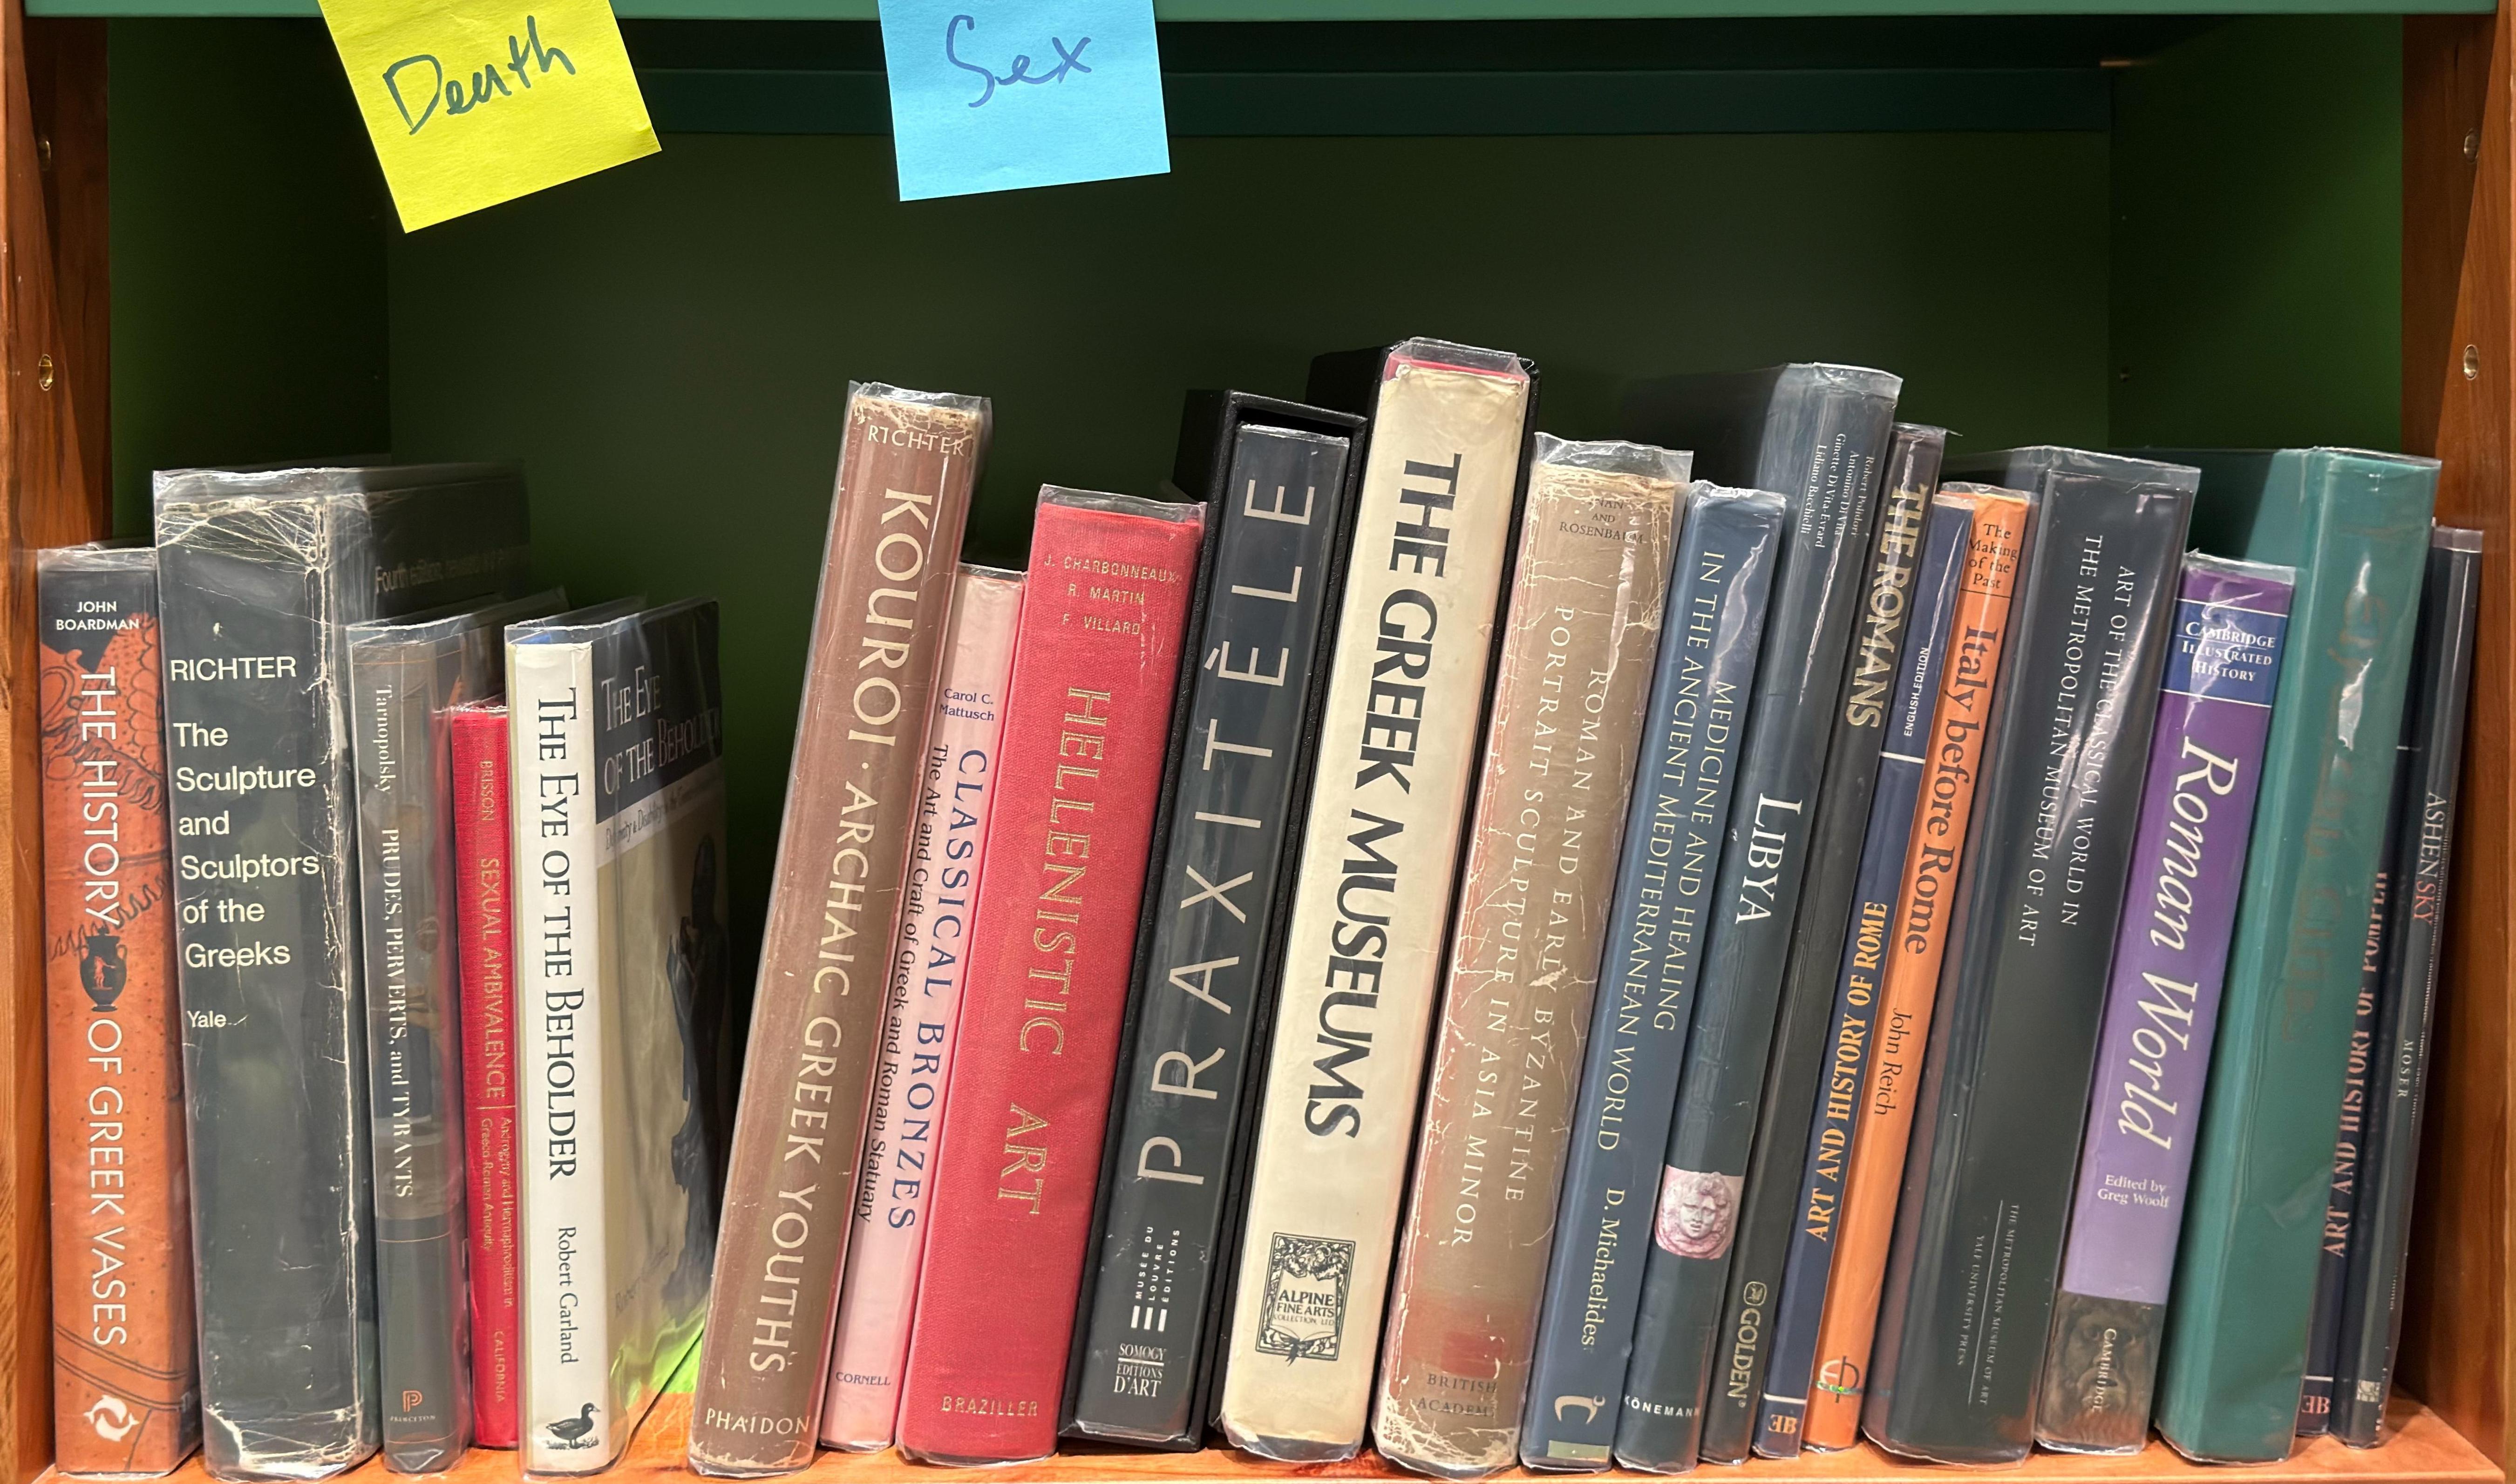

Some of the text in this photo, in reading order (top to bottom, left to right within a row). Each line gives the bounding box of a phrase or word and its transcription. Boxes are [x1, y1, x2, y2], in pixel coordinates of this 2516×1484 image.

[382, 15, 576, 135] Death
[946, 14, 1092, 108] Sex
[868, 425, 965, 457] RICHTER
[1830, 434, 1846, 471] Ginette
[1801, 445, 1827, 534] Lidiano Bacchielli
[1843, 451, 1859, 498] Antonino
[1592, 513, 1615, 523] AND
[1969, 539, 2018, 560] Making
[1984, 523, 2011, 539] The
[1090, 586, 1144, 604] MARTIN
[1969, 557, 2011, 574] of the
[1972, 573, 2001, 589] Past
[56, 618, 139, 631] BOARDMAN
[77, 601, 117, 613] JOHN
[1083, 616, 1141, 635] VILLARD
[1846, 482, 1929, 729] THE ROMANS
[170, 656, 296, 682] RICHTER
[944, 688, 993, 705] Carol C.
[1904, 646, 1929, 737] ENGLISH EDITION
[2195, 661, 2257, 682] HISTORY
[173, 723, 229, 747] The
[373, 684, 396, 794] Tarnopolsky
[940, 704, 994, 721] Mattusch
[2019, 535, 2102, 947] THE METROPOLITAN MUSEUM OF ART
[626, 737, 655, 784] THE
[2061, 566, 2136, 926] ART OF THE CLASSICAL WORLD IN
[176, 765, 316, 795] Sculpture
[478, 761, 494, 821] BRISSON
[1304, 454, 1462, 1138] THE GREEK MUSEUMS
[1904, 625, 1999, 955] Italy before Rome
[179, 811, 230, 835] and
[1137, 479, 1315, 1185] PRAXITÈLE
[1598, 551, 1725, 1151] IN THE ANCIENT MEDITERRANEAN WORLD
[2420, 792, 2447, 878] ASHEN
[181, 854, 320, 883] Sculptors
[542, 851, 570, 895] OF
[1654, 681, 1736, 1030] MEDICINE AND HEALING
[1735, 793, 1802, 924] LIBYA
[183, 898, 265, 924] of the
[750, 488, 932, 1373] KOUROI ARCHAIC GREEK YOUTHS
[1451, 605, 1575, 1247] PORTRAIT SCULPTURE IN ASIA MINOR
[1505, 668, 1608, 1201] ROMAN AND EARLY BYZANTINE
[2413, 881, 2436, 925] SKY
[185, 942, 291, 968] Greeks
[544, 906, 573, 978] THE
[997, 687, 1111, 1214] HELLENISTIC ART
[2118, 736, 2238, 1150] Roman World
[81, 666, 126, 1345] THE HISTORY OF GREEK VASES
[479, 857, 505, 1098] SEXUAL AMBIVALENCE
[857, 745, 949, 1223] The Art and Craft of Greek and Roman Statuary
[888, 749, 987, 1229] CLASSICAL BRONZES
[187, 1010, 226, 1028] Yale
[381, 828, 413, 1198] PRUDES, PERVERTS, and TYRANTS
[545, 989, 584, 1180] BEHOLDER
[1805, 901, 1888, 1242] ART AND HISTORY OF ROME
[1874, 1007, 1913, 1117] John Reich
[2397, 1039, 2413, 1098] MOSER
[2323, 1030, 2371, 1258] ART AND HISTORY
[2098, 1189, 2170, 1208] Greg Woolf
[2104, 1174, 2167, 1195] Edited by
[1135, 1226, 1154, 1300] MUSÉE DU
[1148, 1244, 1163, 1301] LOUVRE
[1161, 1229, 1180, 1302] ÉDITIONS
[1582, 1187, 1625, 1347] D. Michaelides
[1995, 1204, 2020, 1313] THE METROPOLITAN
[558, 1227, 578, 1364] Robert Garland
[1277, 1302, 1334, 1317] FINE ARTS
[1278, 1289, 1334, 1306] ALPINE
[1962, 1264, 1980, 1330] UNIVERSITY
[494, 1330, 505, 1402] CALIFORNIA
[836, 1372, 891, 1385] CORNELL
[1119, 1343, 1167, 1361] SOMOGY
[1427, 1374, 1497, 1393] BRITISH
[1727, 1308, 1761, 1398] GOLDEN
[2092, 1328, 2117, 1412] CAMBRIDGE
[941, 1396, 1038, 1416] BRAZILLER
[1114, 1376, 1161, 1397] D'ART
[705, 1408, 810, 1435] PHAIDON
